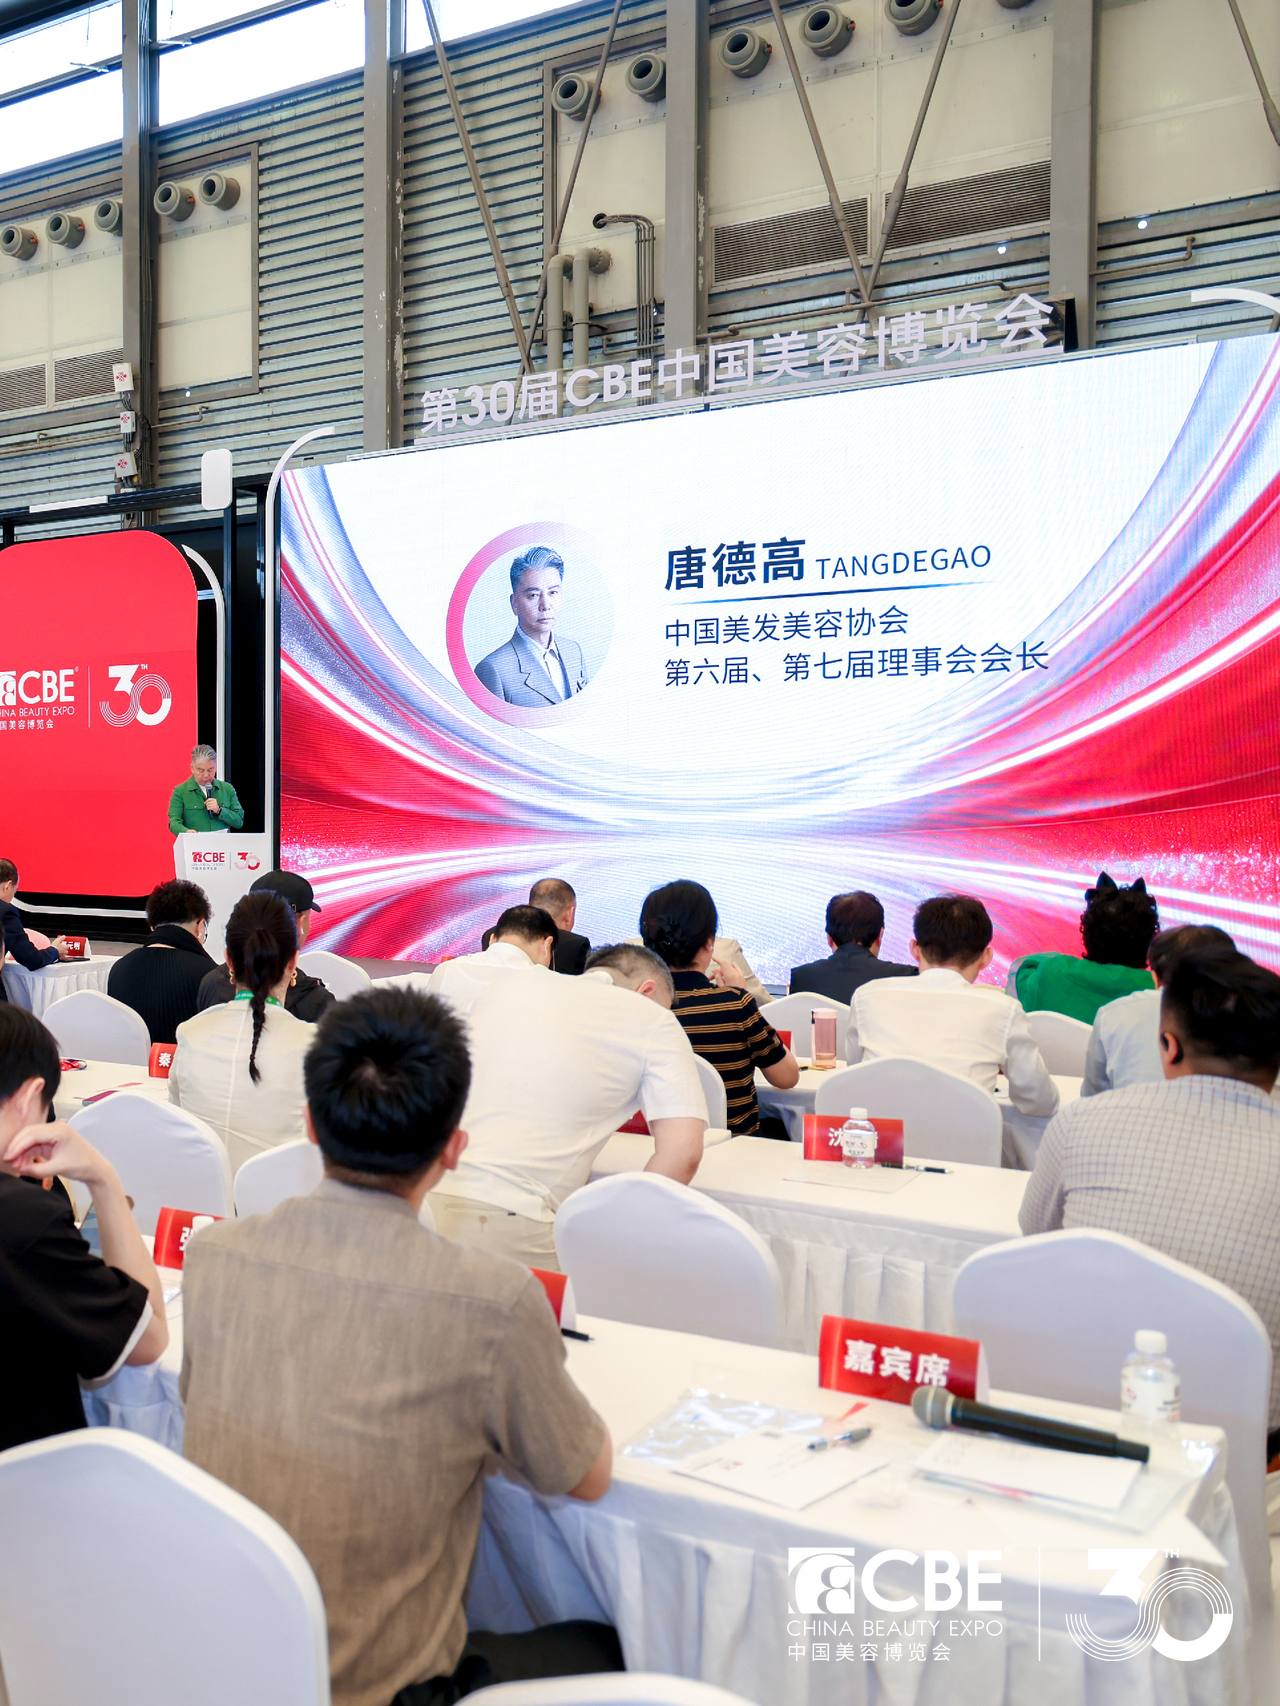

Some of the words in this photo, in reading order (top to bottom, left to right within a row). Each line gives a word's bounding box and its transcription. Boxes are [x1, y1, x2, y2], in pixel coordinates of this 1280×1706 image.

[419, 292, 1055, 434] 第30届CBE中国美容博览会
[664, 536, 807, 591] 唐德高
[815, 545, 992, 580] TANGDEGAO
[665, 604, 909, 648] 中国美发美容协会
[18, 668, 76, 705] CBE
[664, 640, 1050, 688] 第六届、第七届理事会会长
[19, 707, 50, 717] BEAUTY
[52, 705, 76, 716] EXPO
[203, 852, 225, 863] CBE
[843, 1338, 950, 1387] 嘉宾席
